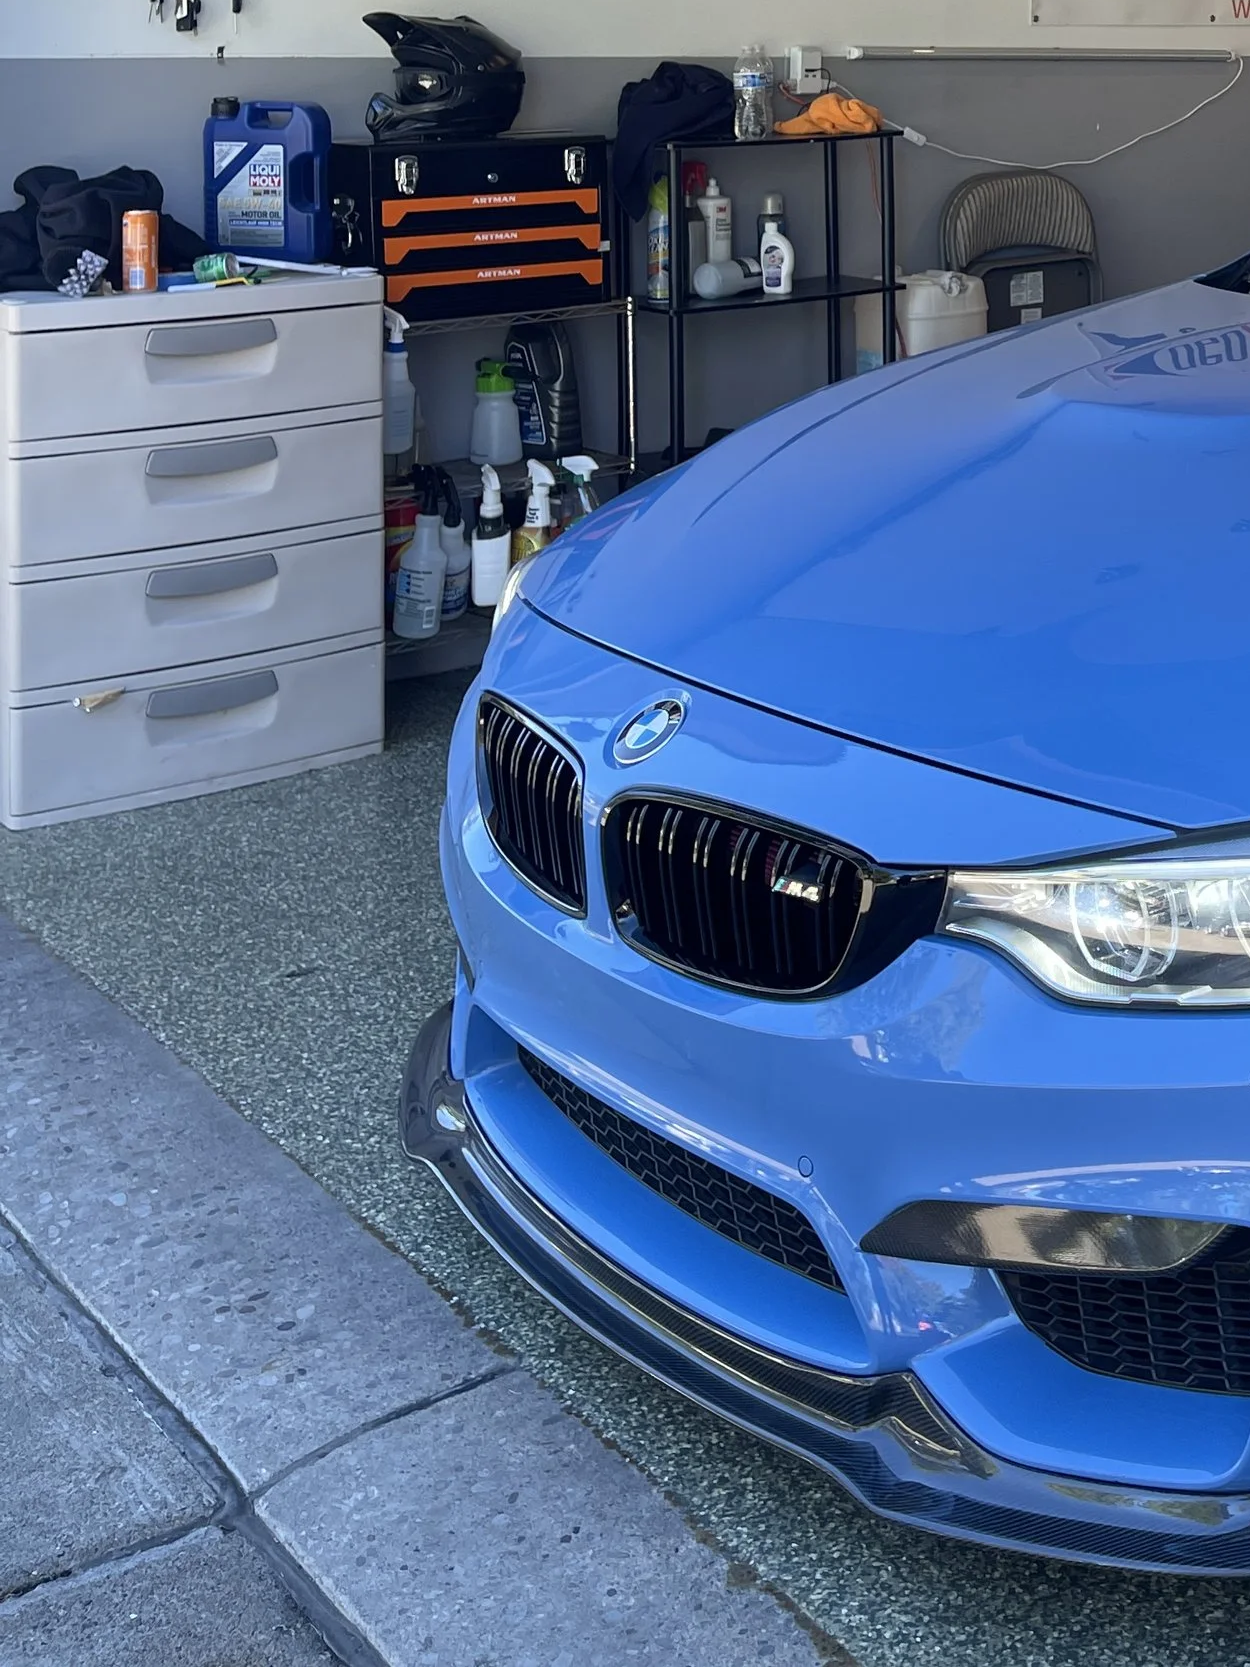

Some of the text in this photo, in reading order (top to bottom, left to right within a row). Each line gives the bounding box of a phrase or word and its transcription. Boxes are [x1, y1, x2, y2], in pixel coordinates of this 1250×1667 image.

[250, 164, 281, 175] LIQUI
[250, 175, 281, 187] MOLY
[472, 195, 516, 205] ARTMAN
[241, 210, 268, 219] MOTOR
[269, 211, 281, 219] OIL
[473, 232, 518, 242] ARTMAN
[477, 269, 521, 279] ARTMAN
